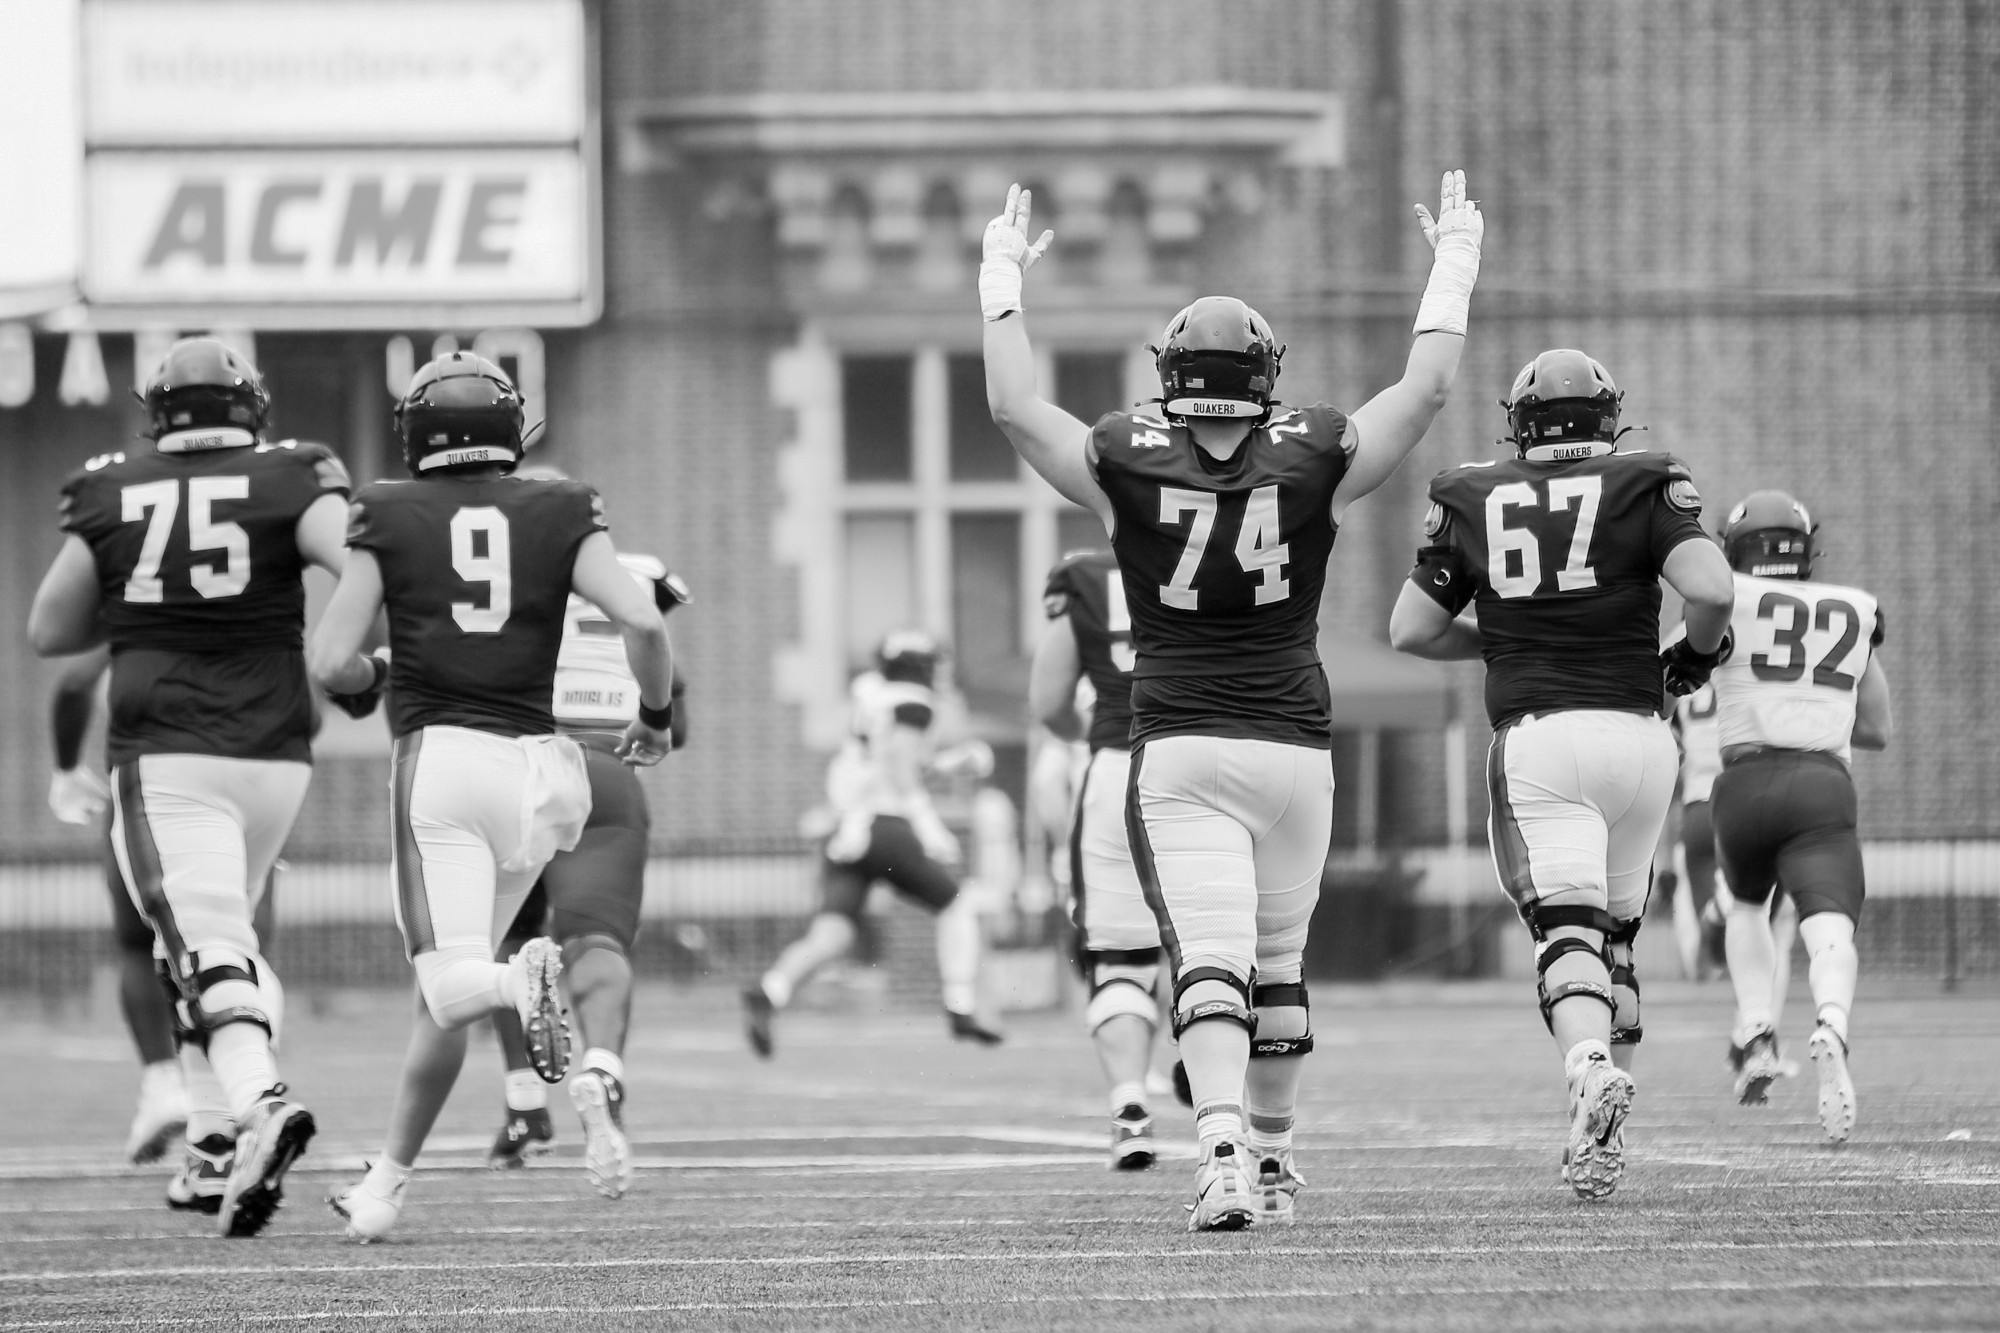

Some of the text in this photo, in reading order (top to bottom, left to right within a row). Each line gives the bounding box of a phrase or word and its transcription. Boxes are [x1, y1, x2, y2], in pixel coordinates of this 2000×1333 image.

[143, 179, 527, 268] ACME
[447, 450, 489, 465] QUAKERS
[1193, 402, 1236, 414] QUAKERS
[1553, 446, 1592, 459] QUAKERS
[121, 474, 250, 603] 75
[449, 506, 511, 632] 9
[1158, 484, 1290, 611] 74
[1485, 473, 1603, 599] 67
[1750, 592, 1860, 691] 32
